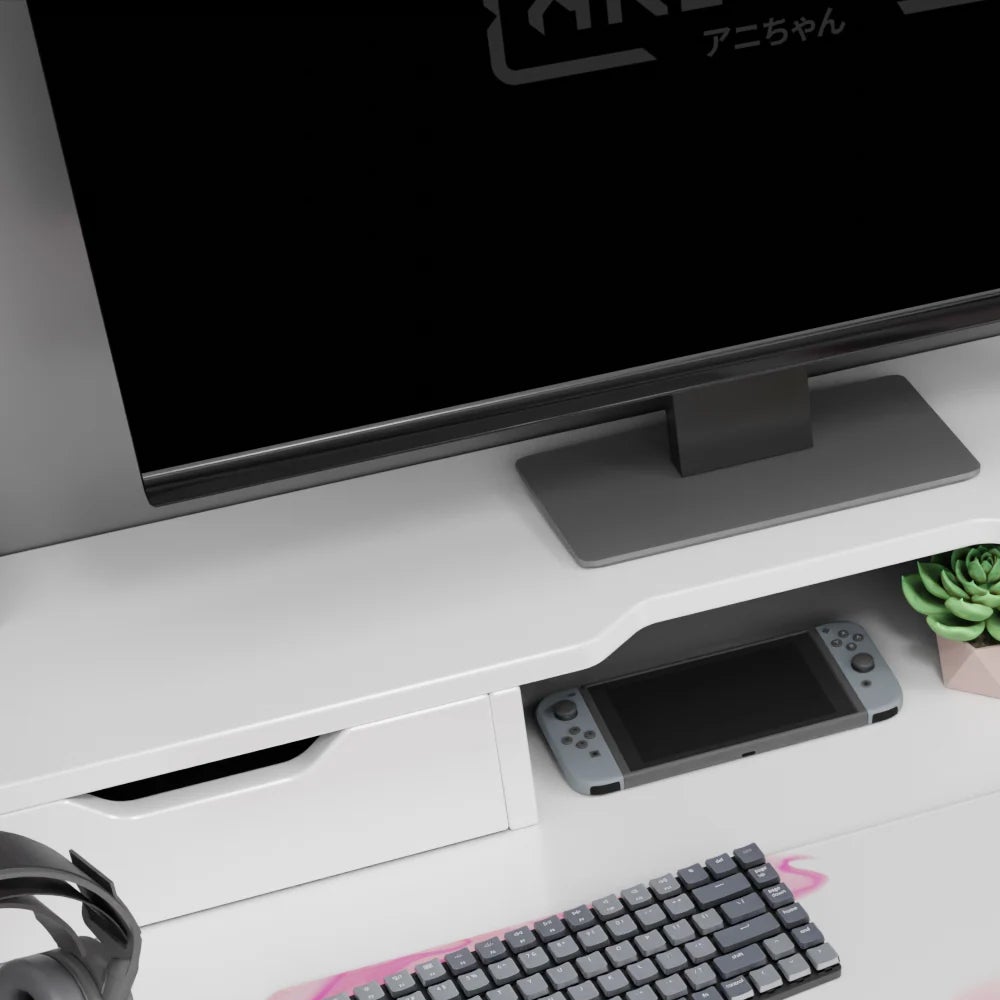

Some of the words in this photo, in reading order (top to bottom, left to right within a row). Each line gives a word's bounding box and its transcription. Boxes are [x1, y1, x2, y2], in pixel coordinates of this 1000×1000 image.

[703, 8, 847, 58] アニちゃん
